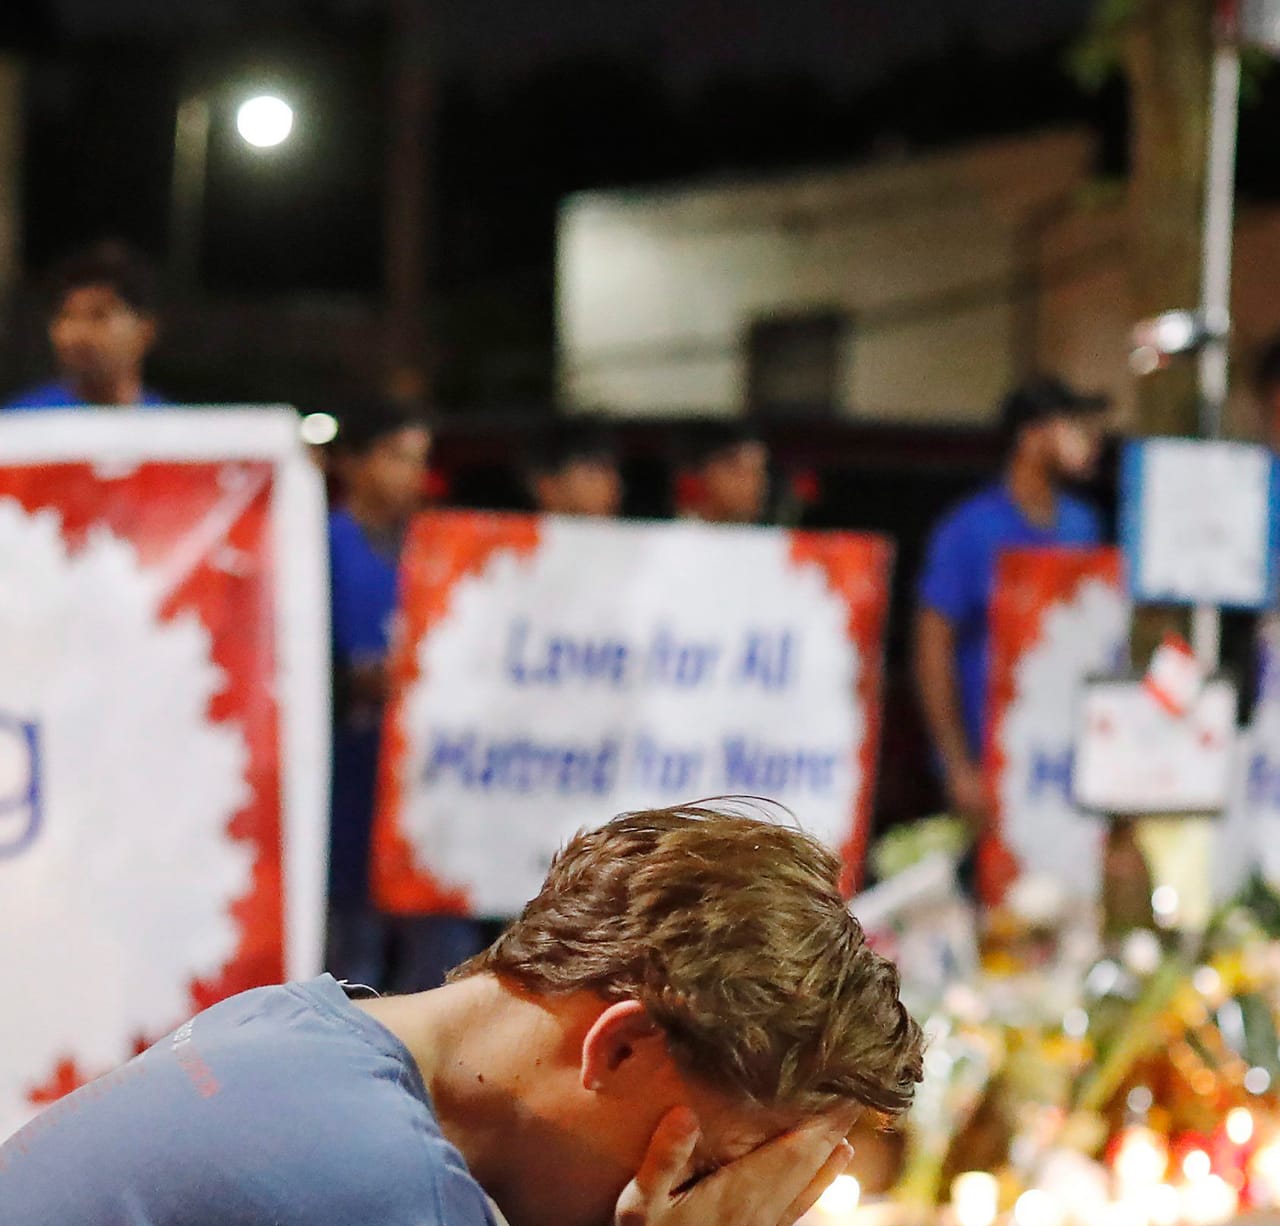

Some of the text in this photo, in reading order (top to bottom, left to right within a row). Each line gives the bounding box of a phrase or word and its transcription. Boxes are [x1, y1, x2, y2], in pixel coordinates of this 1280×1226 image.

[503, 619, 799, 694] Love for All
[632, 724, 706, 795] for
[721, 728, 838, 797] None
